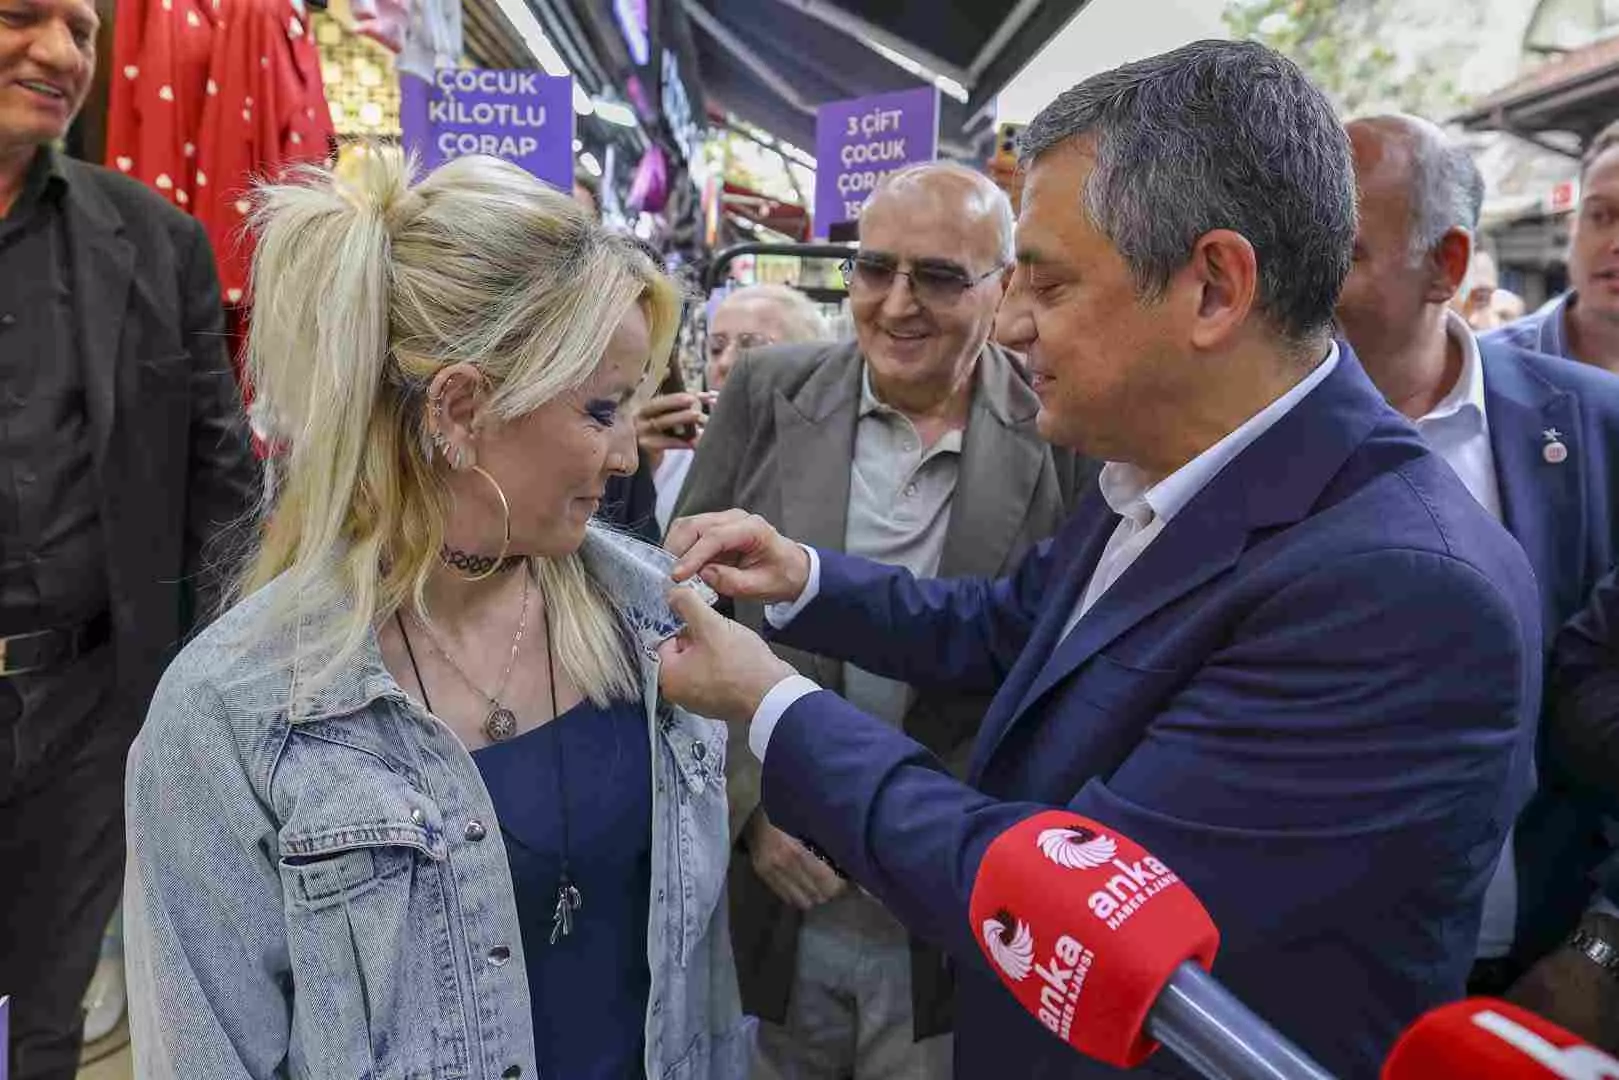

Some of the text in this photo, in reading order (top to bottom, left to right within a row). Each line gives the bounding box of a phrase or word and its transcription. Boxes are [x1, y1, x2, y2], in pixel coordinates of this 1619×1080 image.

[436, 69, 538, 95] ÇOCUK
[428, 96, 546, 127] KİLOTLU
[846, 107, 903, 140] 3 ÇİFT
[840, 137, 906, 170] ÇOCUK
[1088, 855, 1172, 921] anka
[1106, 892, 1148, 931] HABER
[1034, 934, 1084, 1033] anka
